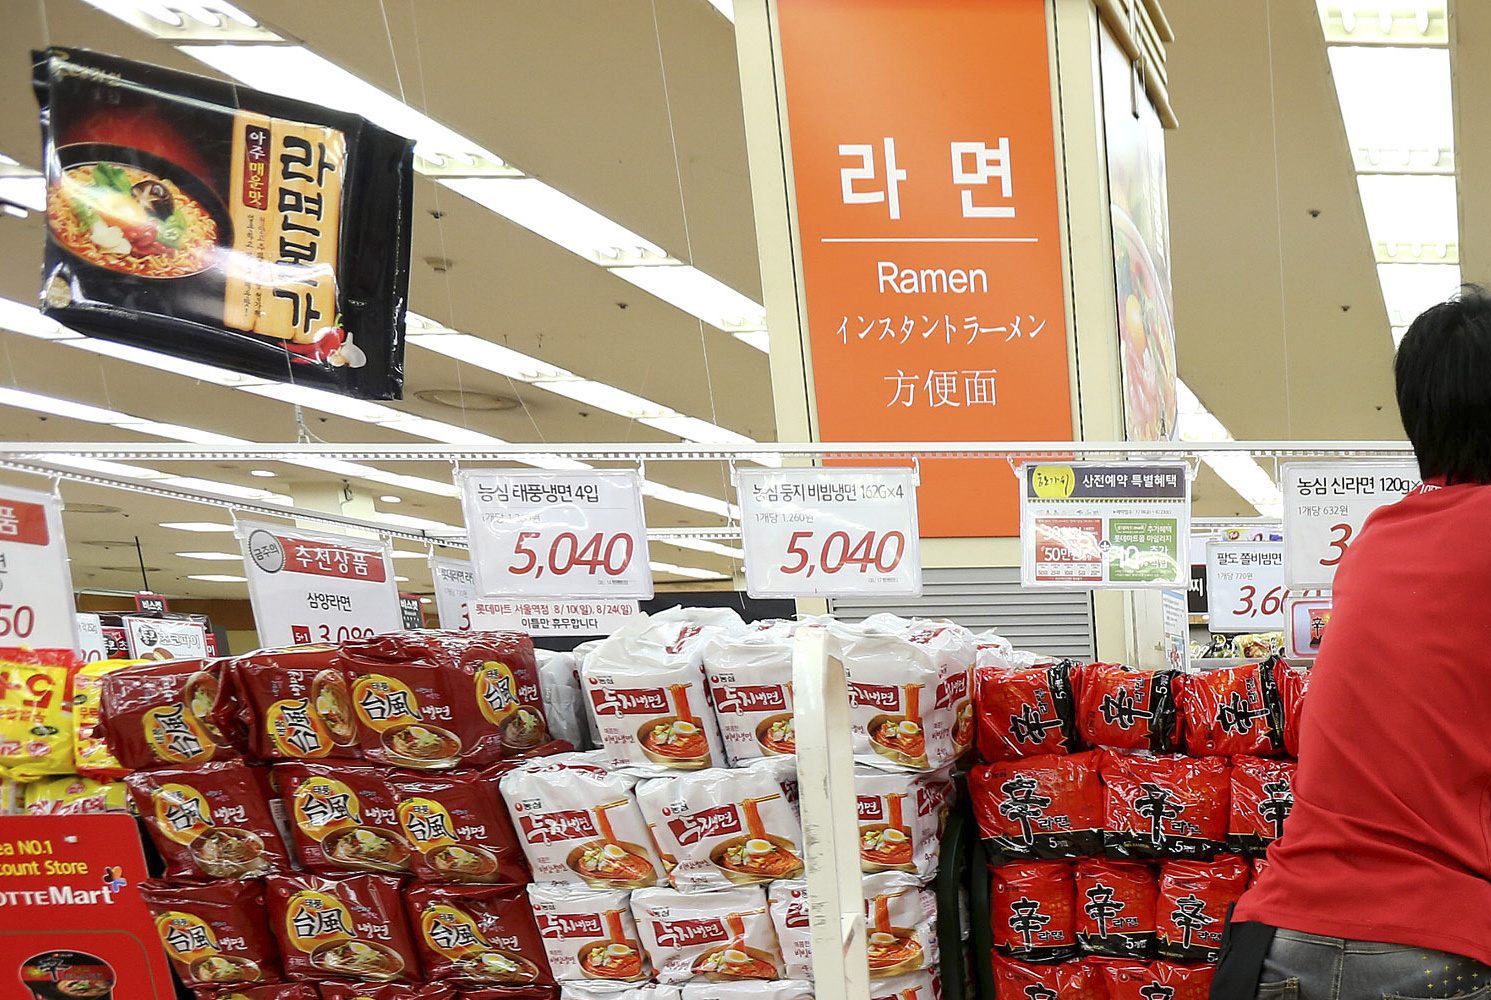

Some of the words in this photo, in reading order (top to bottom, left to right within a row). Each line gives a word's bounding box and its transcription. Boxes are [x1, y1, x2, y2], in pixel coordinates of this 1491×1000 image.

[249, 131, 267, 160] 아주
[248, 161, 265, 207] 매운맛
[877, 261, 989, 294] Ramen
[836, 314, 1047, 344] インスタントラーメン
[883, 368, 998, 408] 方便面
[1082, 474, 1128, 488] 사전예약
[1131, 474, 1177, 488] 특별혜택
[1297, 477, 1327, 495] 농심
[1331, 477, 1375, 494] 신라면
[512, 484, 573, 503] 태풍냉면
[575, 484, 600, 502] 4입
[753, 484, 778, 502] 농심
[780, 483, 805, 502] 둥지
[808, 483, 857, 502] 비빔냉면
[1298, 506, 1321, 516] 1개당
[1323, 505, 1348, 516] 632원
[254, 541, 279, 561] 금주의
[296, 546, 369, 576] 추천상품
[508, 532, 634, 578] 5,040
[780, 531, 905, 578] 5,040
[1217, 552, 1239, 566] 팔도
[1240, 552, 1282, 566] 쫄비빔면
[307, 592, 353, 612] 삼양라면
[475, 604, 512, 615] 롯데마트
[515, 604, 550, 615] 서울역점
[521, 618, 549, 629] 이틀만
[552, 618, 598, 630] 휴무합니다
[361, 686, 422, 722] 台風
[597, 686, 667, 716] 둥지냉면
[1098, 686, 1154, 730] 辛
[422, 703, 452, 721] 냉면
[999, 774, 1051, 845] 辛
[1038, 815, 1070, 829] 라면
[18, 840, 53, 855] NO.1
[41, 860, 89, 875] Store
